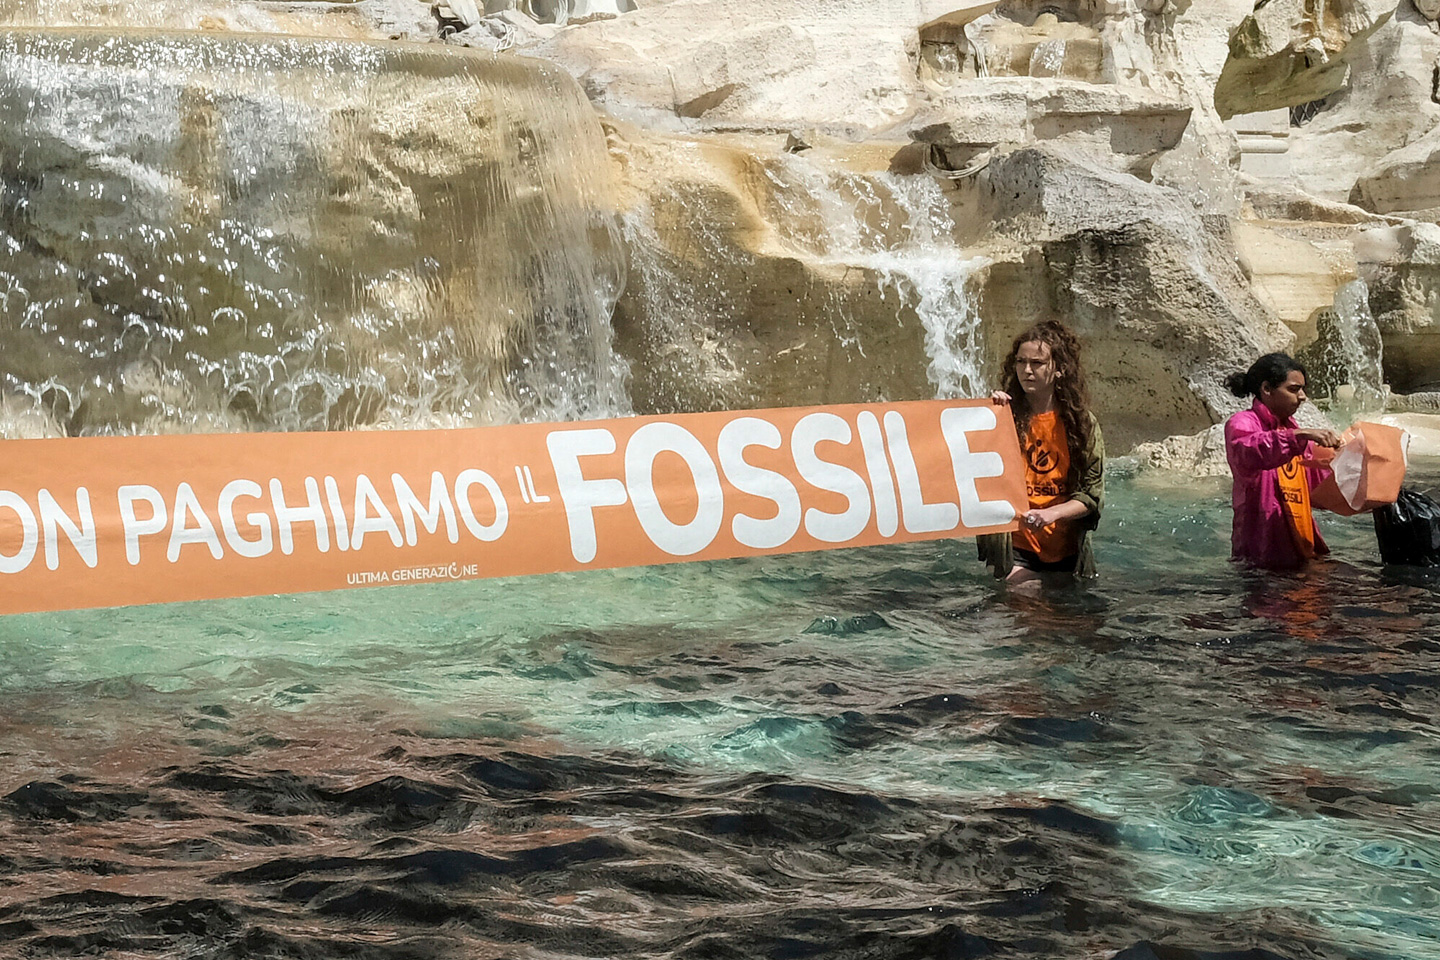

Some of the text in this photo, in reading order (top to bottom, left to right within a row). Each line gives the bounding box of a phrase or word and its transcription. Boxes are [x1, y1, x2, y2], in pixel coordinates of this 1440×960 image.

[117, 468, 509, 565] PAGHIAMO
[515, 465, 550, 504] IL
[546, 406, 1016, 564] FOSSILE
[347, 571, 389, 584] ULTIMA
